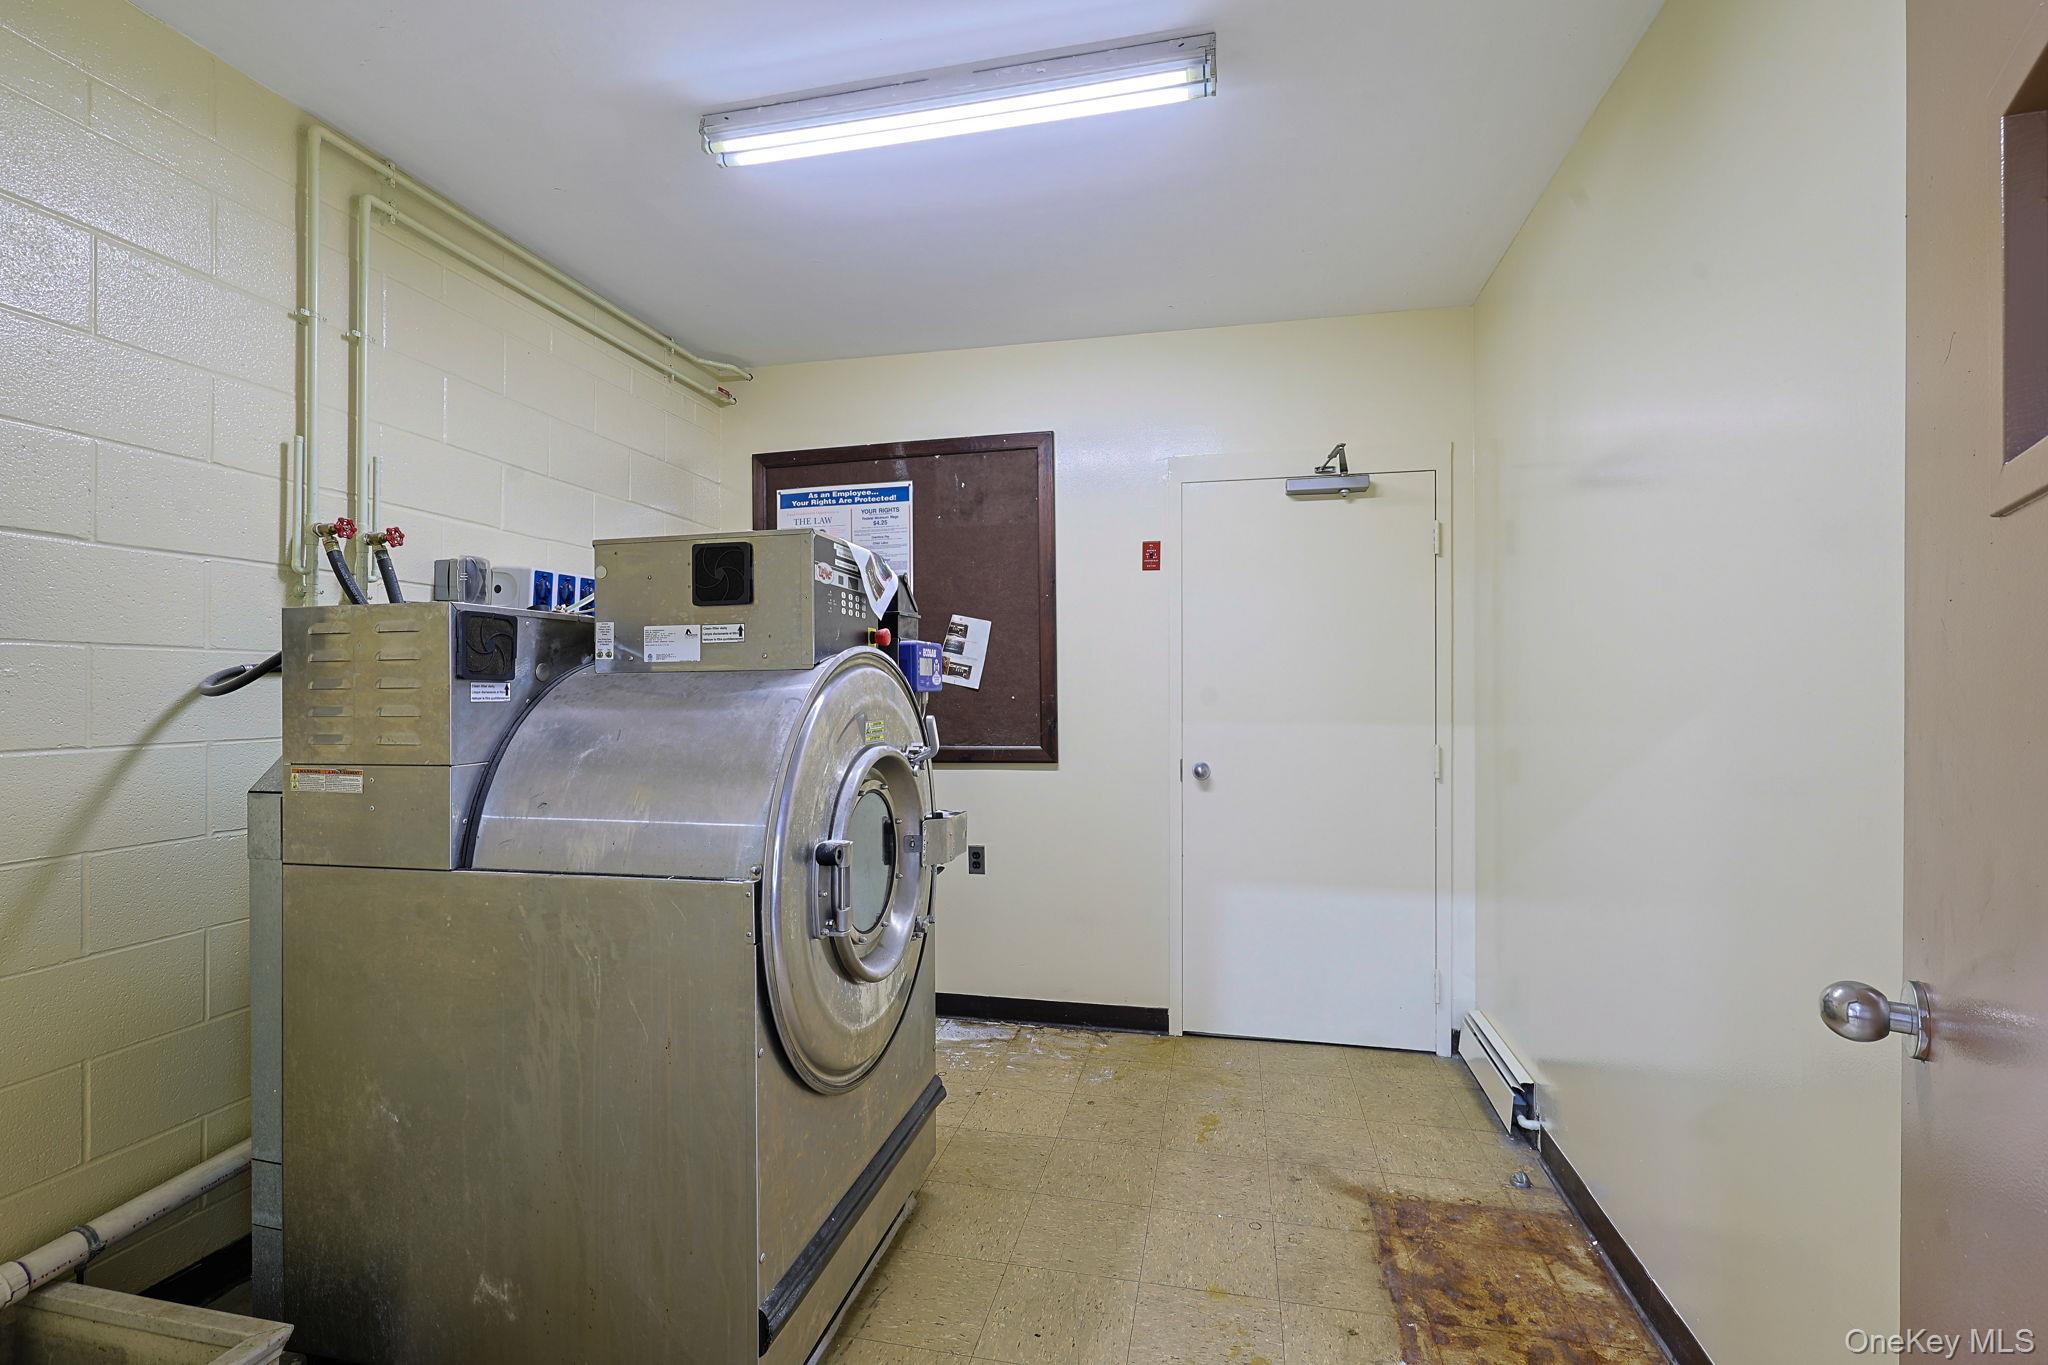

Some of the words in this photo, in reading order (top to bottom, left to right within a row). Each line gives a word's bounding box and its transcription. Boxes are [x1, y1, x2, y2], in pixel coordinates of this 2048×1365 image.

[832, 490, 879, 498] Employee...
[811, 498, 836, 506] Rights
[854, 494, 897, 503] Protected!
[878, 506, 900, 514] RIGHTS
[794, 517, 811, 526] THE
[813, 516, 833, 525] LAW
